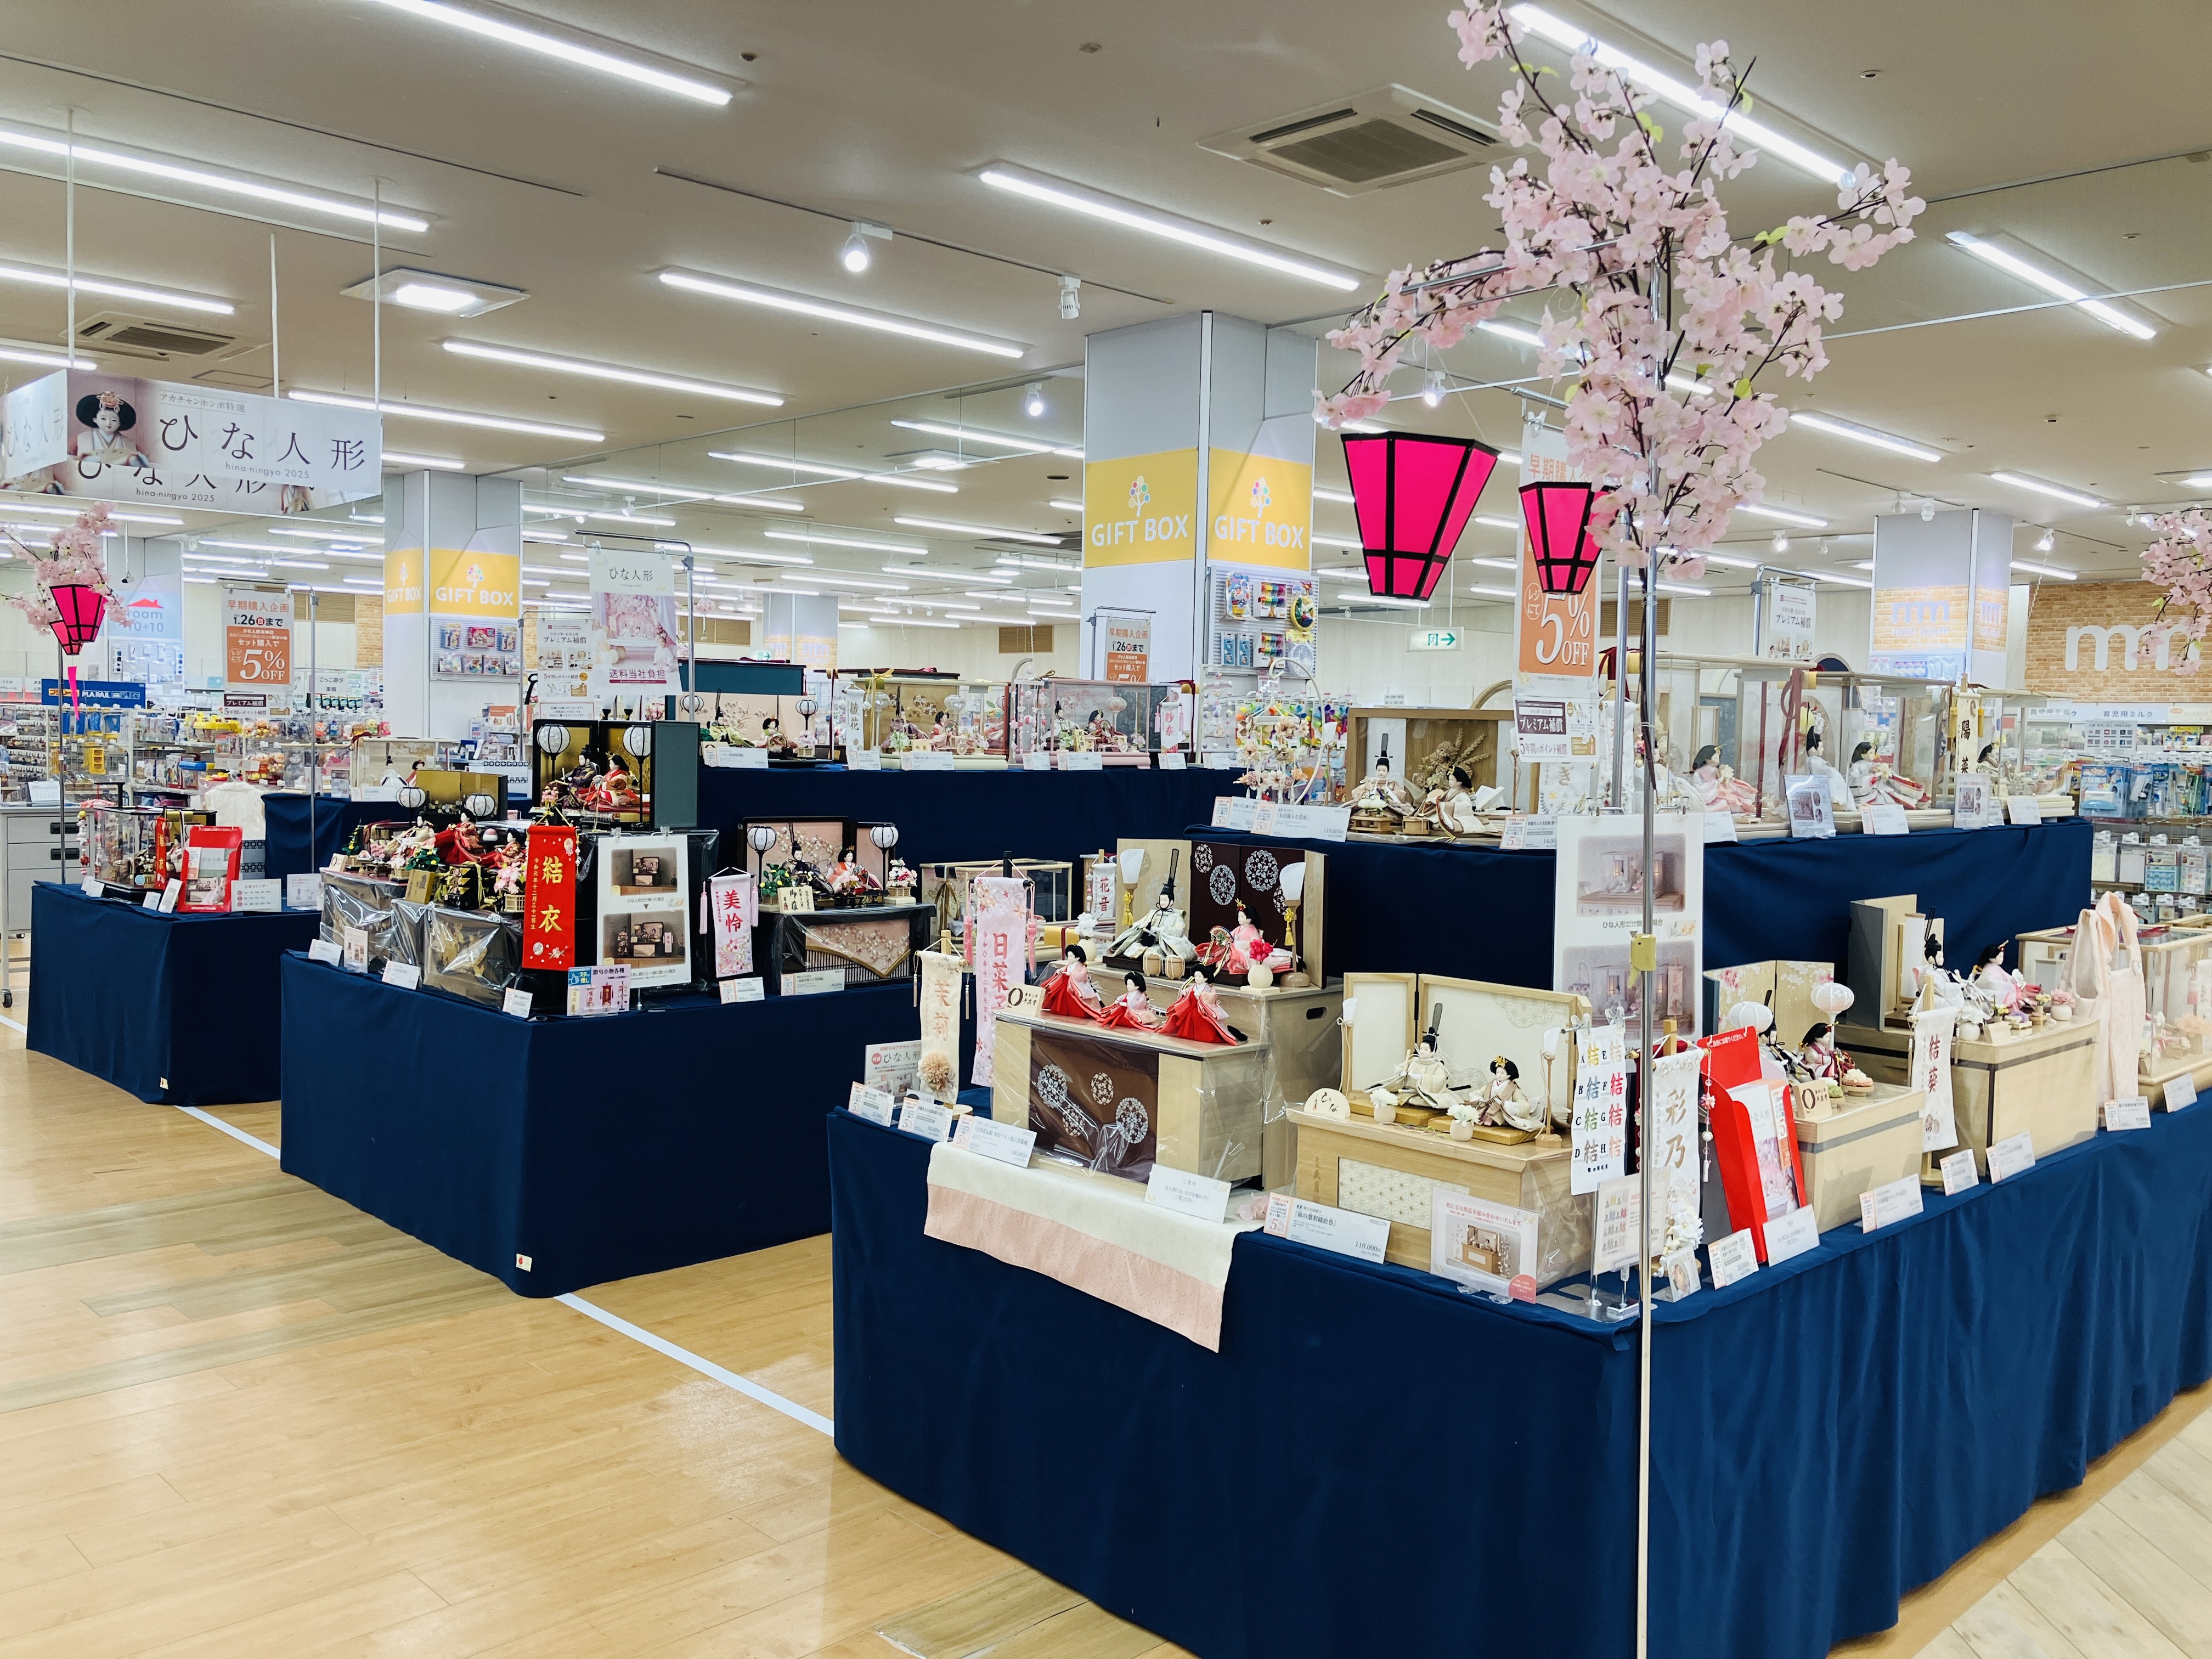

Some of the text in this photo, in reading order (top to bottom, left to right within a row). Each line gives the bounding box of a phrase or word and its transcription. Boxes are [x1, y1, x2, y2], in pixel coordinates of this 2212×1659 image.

[160, 393, 246, 413] アカチャンホンポ特選
[7, 404, 64, 458] ひな人形
[160, 415, 365, 471] ひな人形
[225, 461, 310, 479] hina-ningyo 2025
[1528, 454, 1590, 482] 早期購入企
[136, 488, 215, 502] hina-ningyo 2025
[1091, 514, 1188, 547] GIFT BOX
[1215, 515, 1304, 549] GIFT BOX
[610, 567, 653, 582] ひな人形
[386, 585, 421, 603] GIFT BOX
[436, 586, 513, 606] GIFT BOX
[127, 610, 163, 619] room
[227, 600, 289, 613] 早期購入企画
[1536, 592, 1590, 664] 5%
[1776, 613, 1811, 629] プレミアム補償
[238, 638, 280, 647] セット購入で
[1109, 628, 1148, 639] 早期購入企画
[1562, 642, 1590, 666] OFF
[261, 670, 285, 680] OFF
[609, 668, 665, 679] 送料当社負担
[1114, 664, 1141, 672] セット購入で
[82, 690, 111, 698] PLARAIL
[2103, 710, 2153, 719] 育児用ミルク
[1520, 716, 1563, 732] プレミアム補償
[1961, 719, 1971, 774] 陽菜
[538, 856, 563, 933] 結衣
[1099, 877, 1110, 912] 花音
[724, 889, 743, 933] 美怜
[1602, 919, 1663, 928] ひな人形だけ飾場合
[592, 967, 624, 975] 節句小物各種
[933, 979, 951, 1042] 茉莉
[880, 1043, 922, 1052] 初節句はアカチャンホン
[1581, 1039, 1622, 1067] A 結 E 結
[884, 1050, 921, 1064] ひな人形
[1578, 1072, 1623, 1101] B 結 F 結
[1321, 1092, 1339, 1112] ひな
[1576, 1103, 1623, 1132] C 結 G 結
[1751, 1109, 1770, 1122] な人形
[1664, 1088, 1686, 1169] 彩乃
[1575, 1135, 1622, 1164] D 結 H 結
[1355, 1241, 1381, 1253] 110,000円
